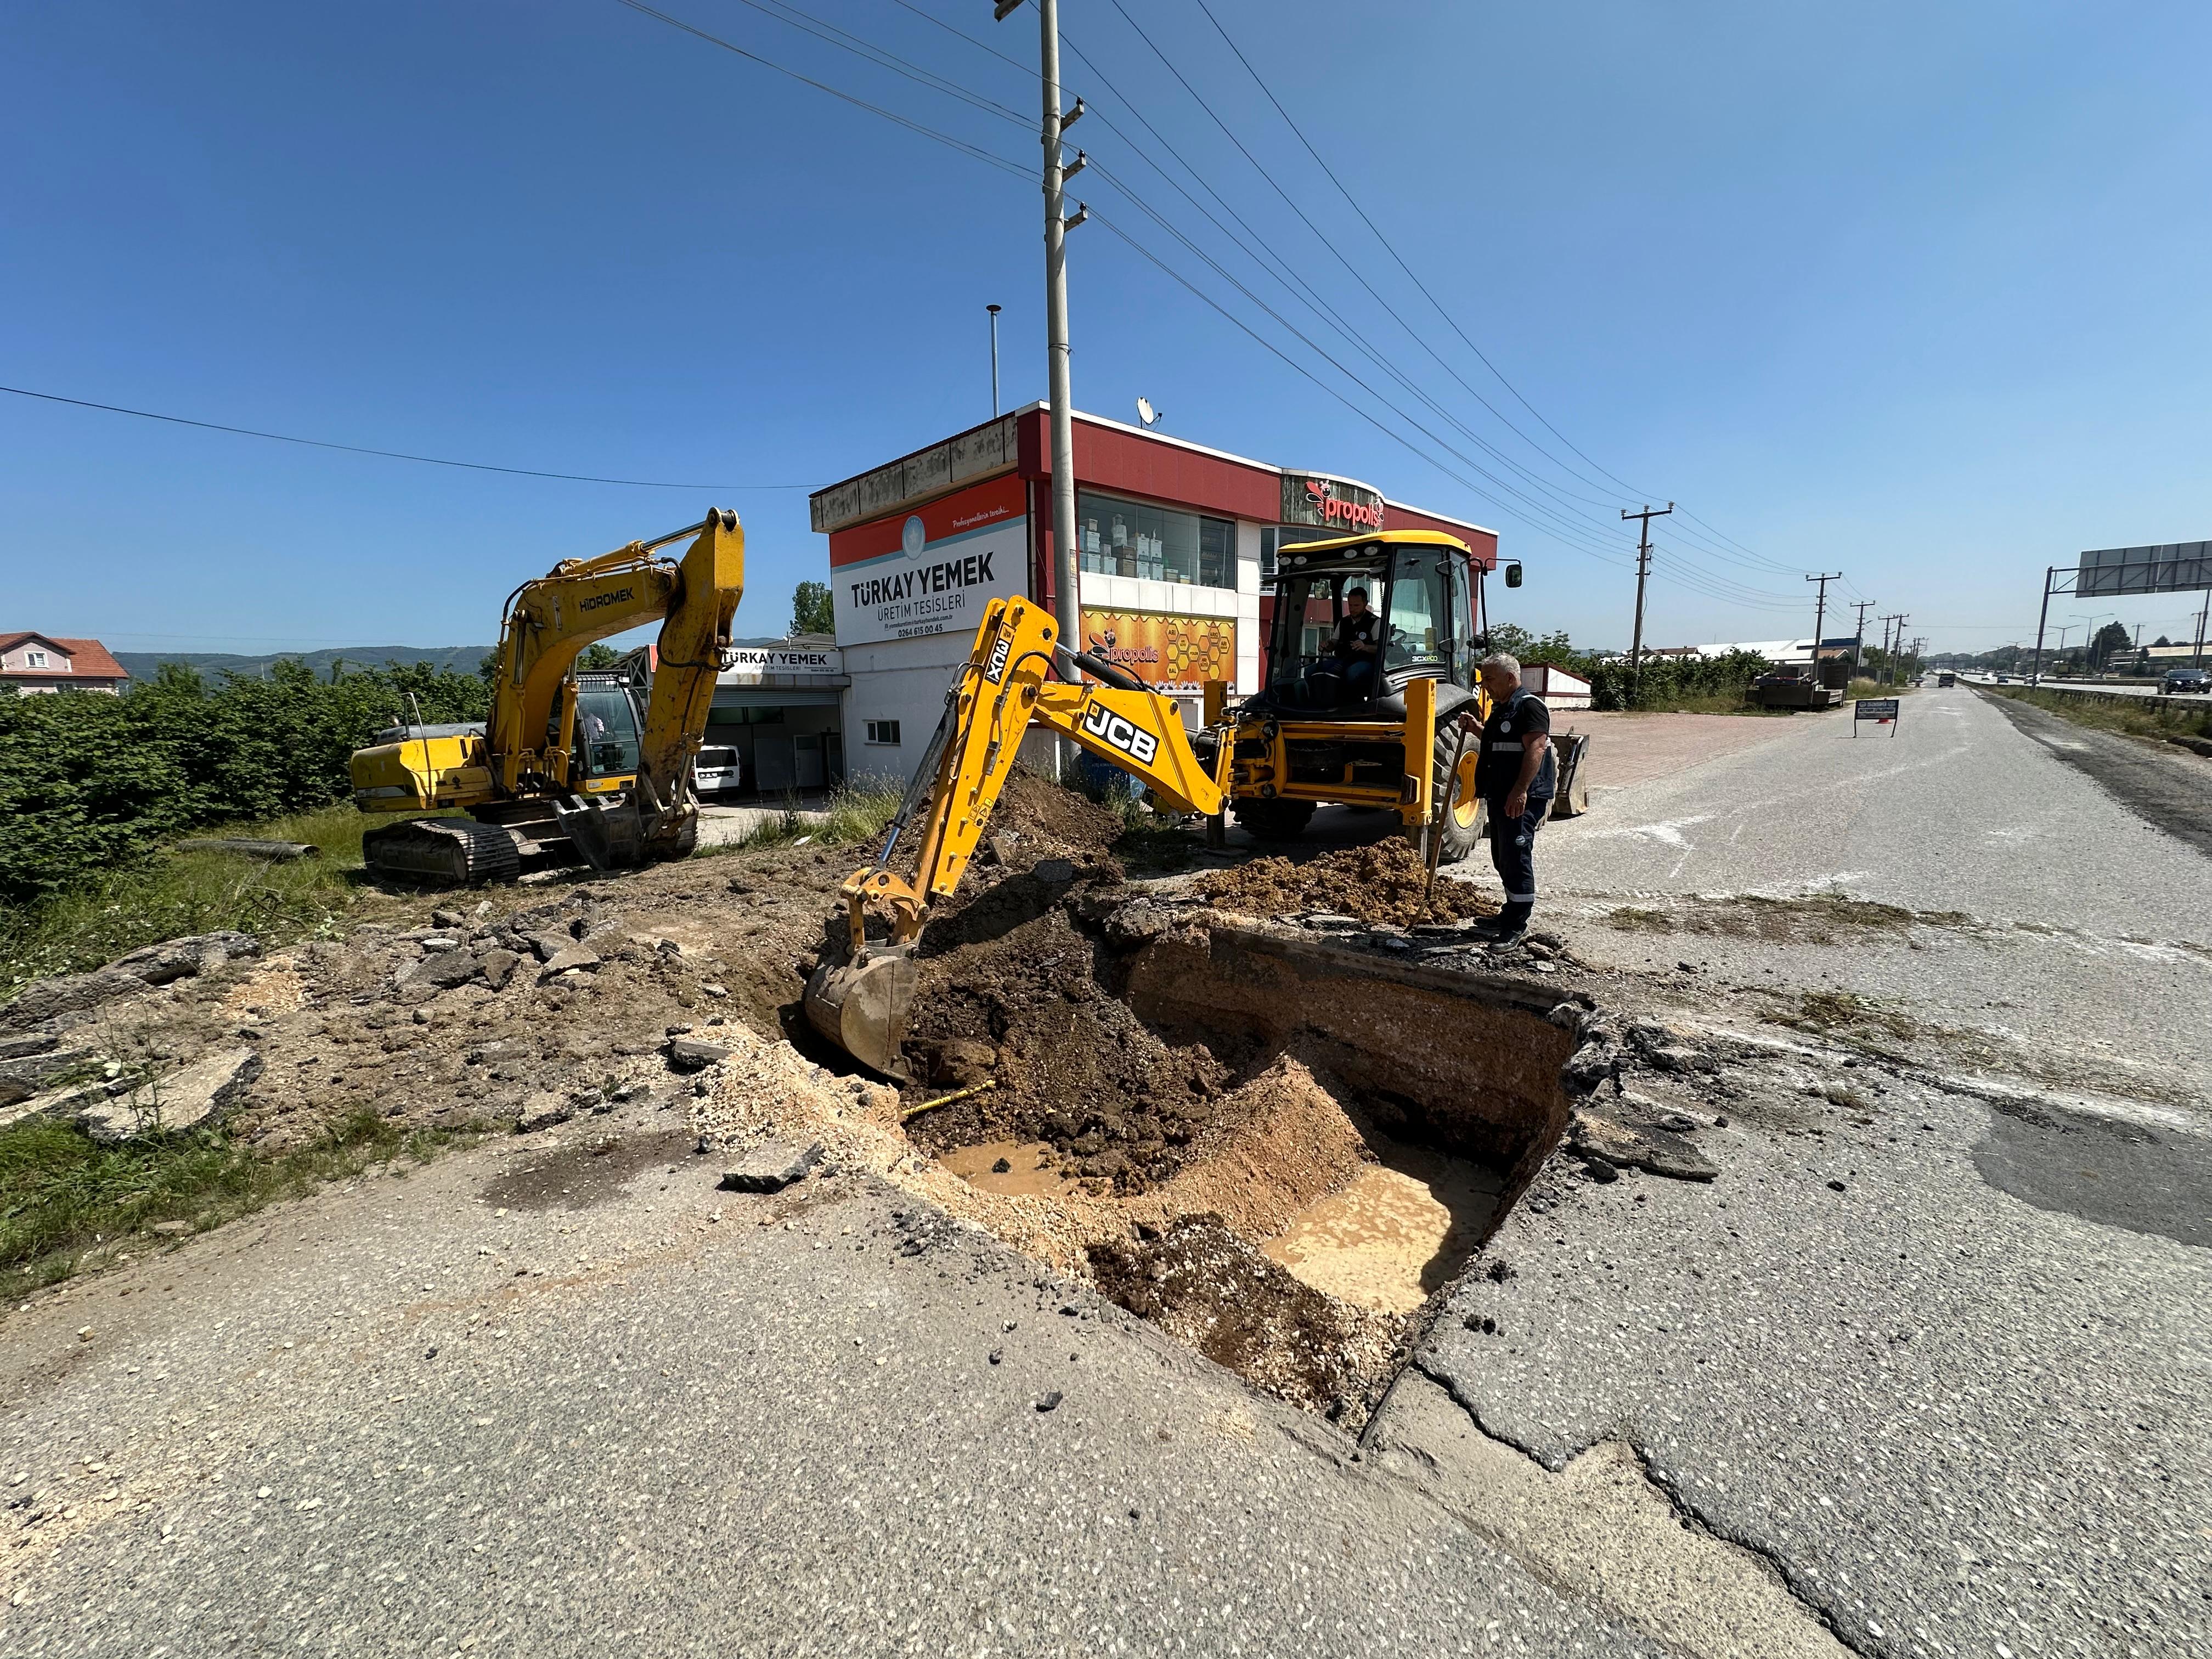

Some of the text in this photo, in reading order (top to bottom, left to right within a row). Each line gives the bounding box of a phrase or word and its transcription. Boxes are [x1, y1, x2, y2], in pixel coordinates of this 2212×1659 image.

[1325, 498, 1378, 527] propolis
[851, 551, 995, 608] TÜRKAY YEMEK
[878, 590, 966, 622] ÜRETİM TESİSLERİ
[898, 623, 943, 637] 0264 615 00 45
[723, 652, 827, 665] TÜRKAY YEMEK
[986, 639, 1009, 681] 3CX
[1110, 646, 1159, 664] propolis
[1086, 710, 1156, 763] JCB
